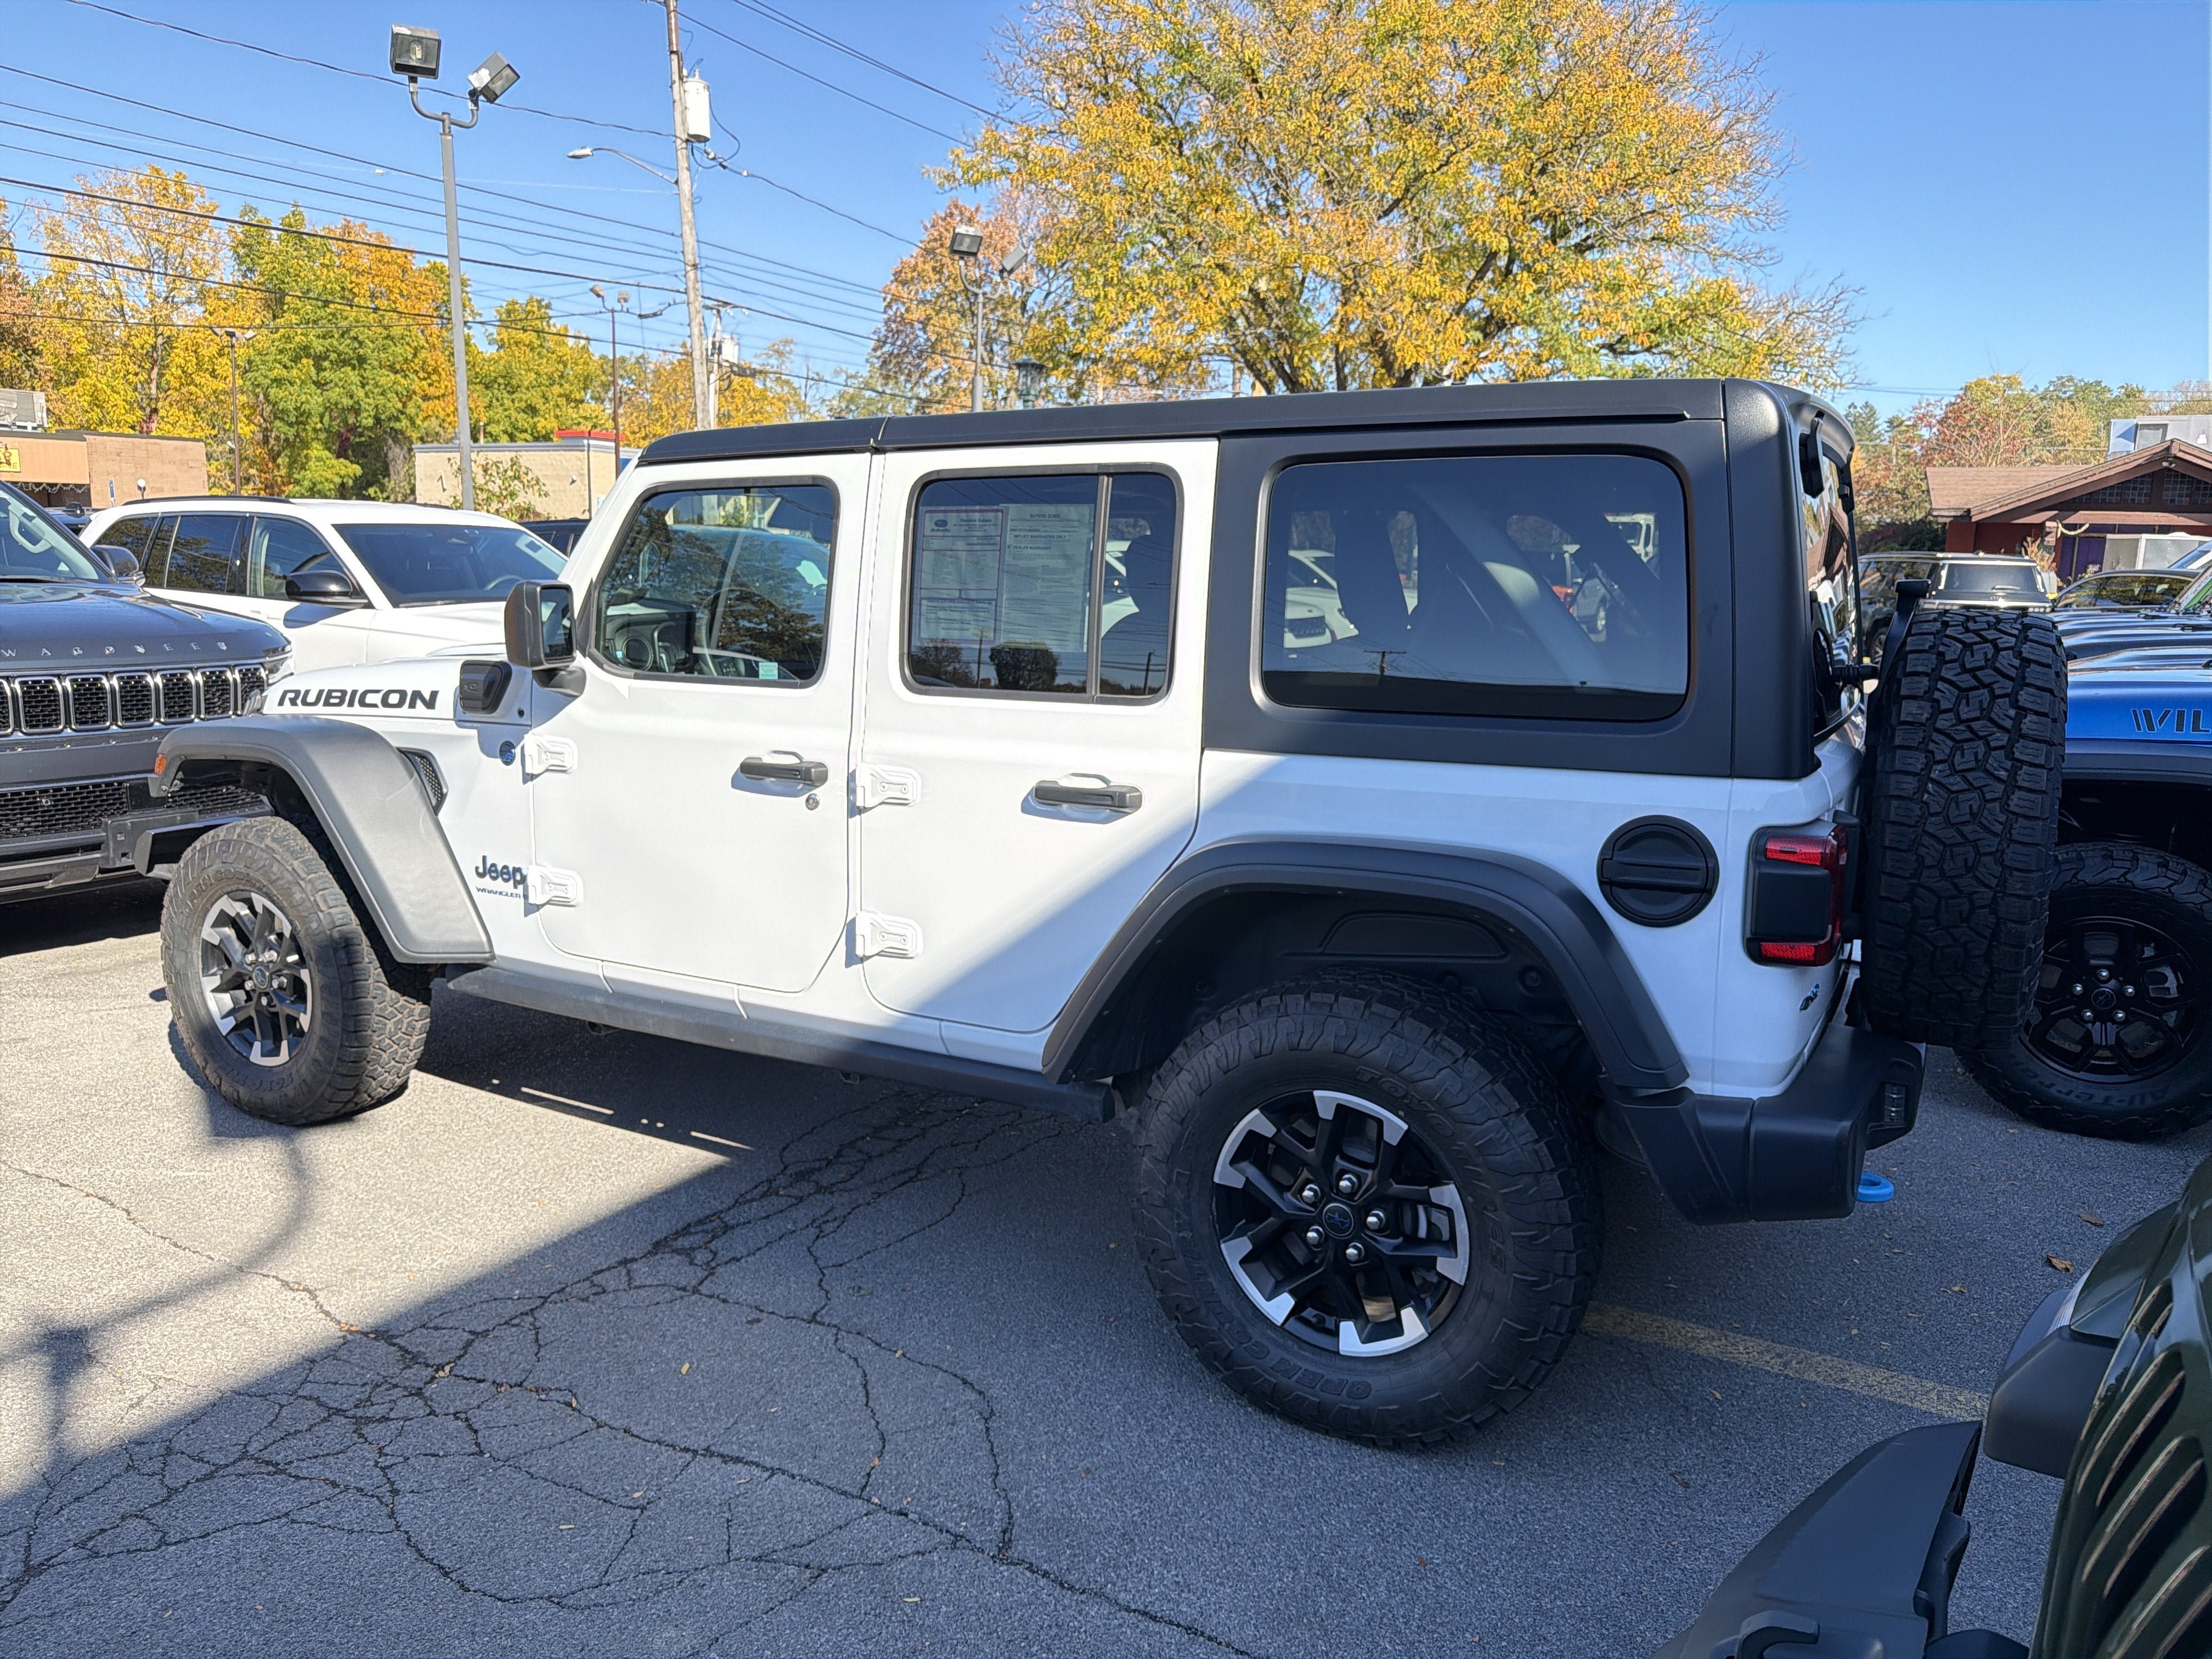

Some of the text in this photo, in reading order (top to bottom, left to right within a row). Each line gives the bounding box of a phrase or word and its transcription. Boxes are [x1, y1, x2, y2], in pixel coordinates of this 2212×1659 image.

[0, 641, 228, 659] WAGONEER
[277, 689, 439, 710] RUBICON
[2131, 708, 2211, 733] WIL
[475, 855, 527, 889] Jeep
[475, 886, 521, 899] WRANGLER
[1355, 1065, 1455, 1137] TOYO
[1270, 1357, 1372, 1400] OPEN
